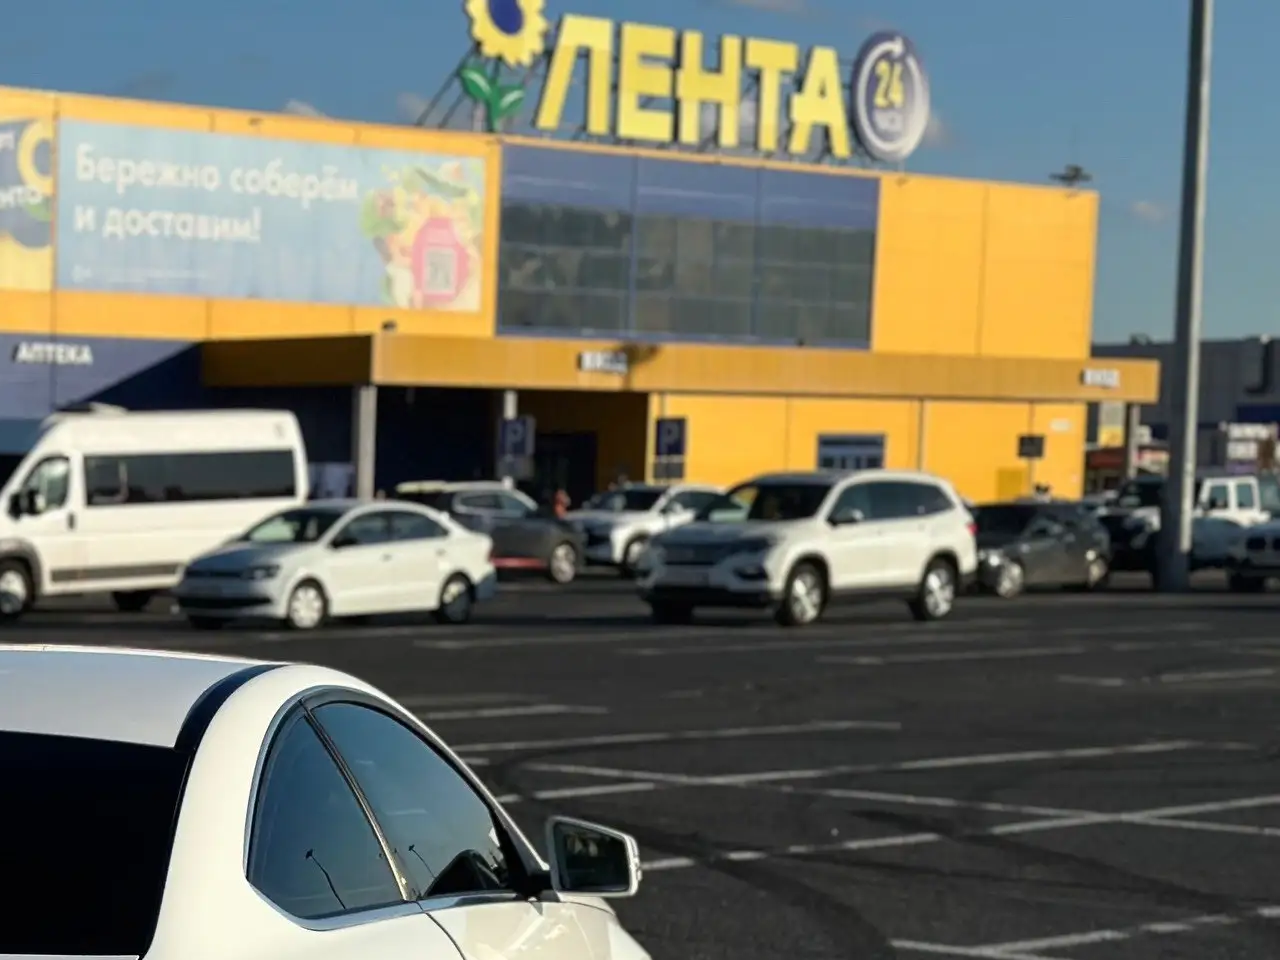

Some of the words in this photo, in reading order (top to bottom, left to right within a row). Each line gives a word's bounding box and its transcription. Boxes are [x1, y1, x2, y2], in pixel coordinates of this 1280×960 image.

[536, 14, 851, 158] ЛЕНТА
[874, 59, 904, 110] 24
[76, 144, 220, 194] Бережно
[230, 157, 359, 208] соберём
[74, 204, 96, 232] и
[102, 206, 261, 243] доставим!
[16, 342, 93, 365] АПТЕКА
